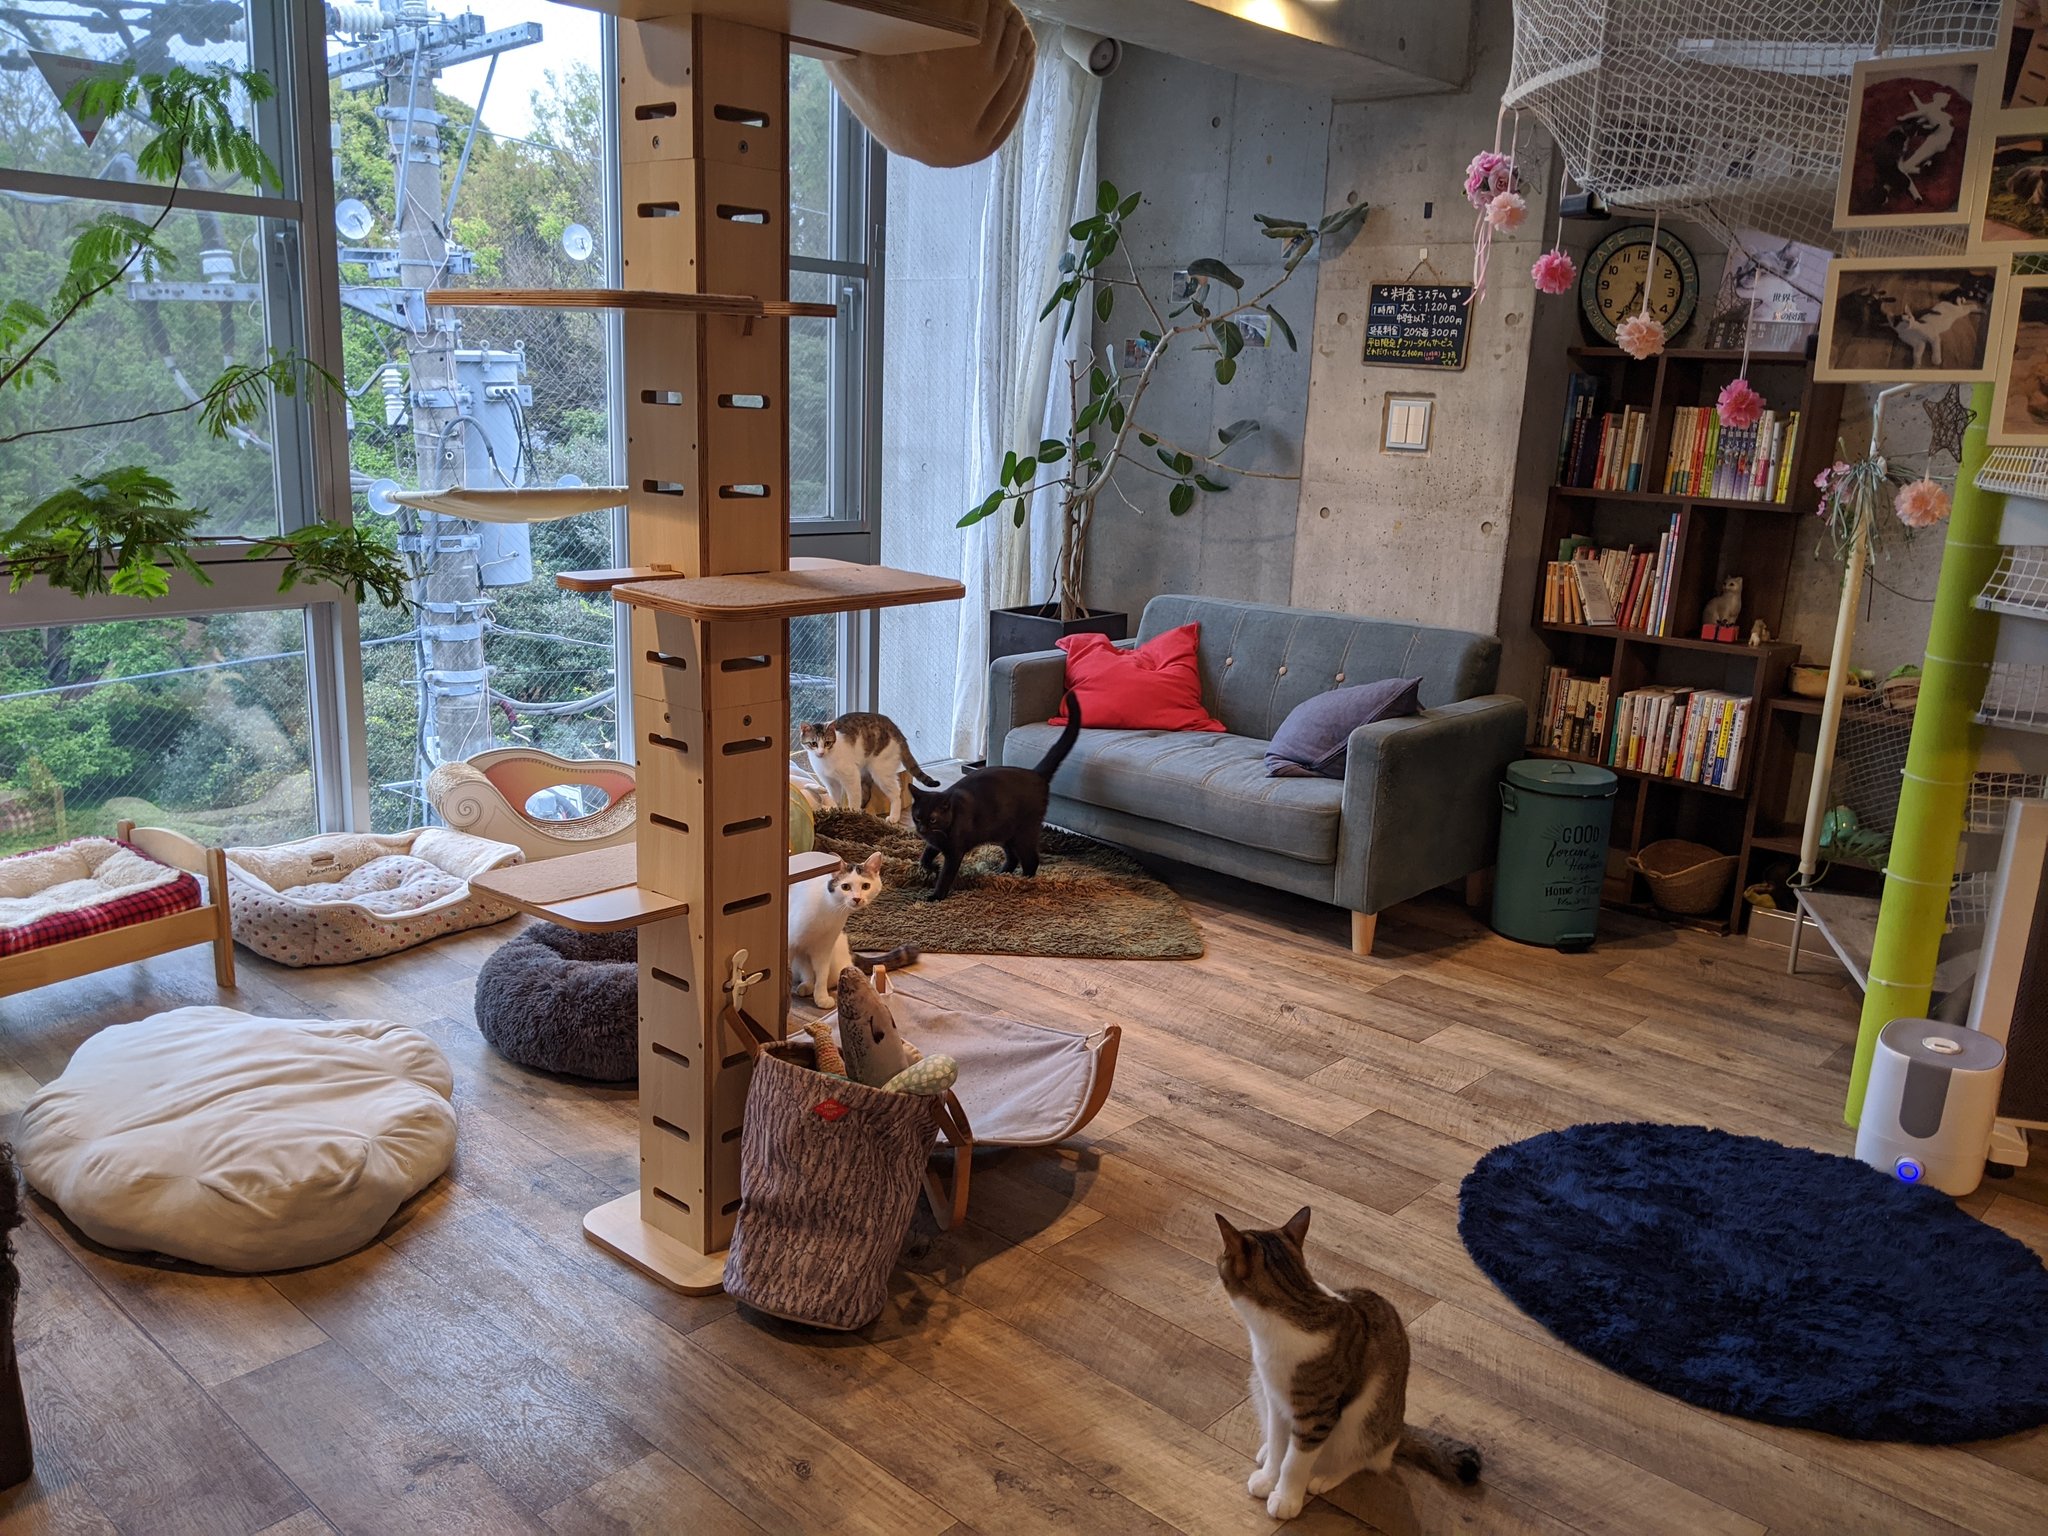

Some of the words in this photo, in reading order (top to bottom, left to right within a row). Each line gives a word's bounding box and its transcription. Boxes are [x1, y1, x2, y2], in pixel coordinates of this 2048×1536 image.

[1587, 232, 1627, 275] CAFE
[1664, 236, 1695, 283] TOUR
[1623, 253, 1631, 263] 11
[1637, 250, 1649, 260] 12
[1608, 265, 1619, 276] 10
[1663, 268, 1673, 280] 2
[1600, 280, 1610, 291] 9
[1390, 286, 1448, 301] 料金システム
[1667, 287, 1675, 298] 3
[1603, 298, 1613, 309] 8
[1659, 303, 1669, 314] 4
[1562, 824, 1600, 844] GOOD
[1545, 886, 1573, 897] Home
